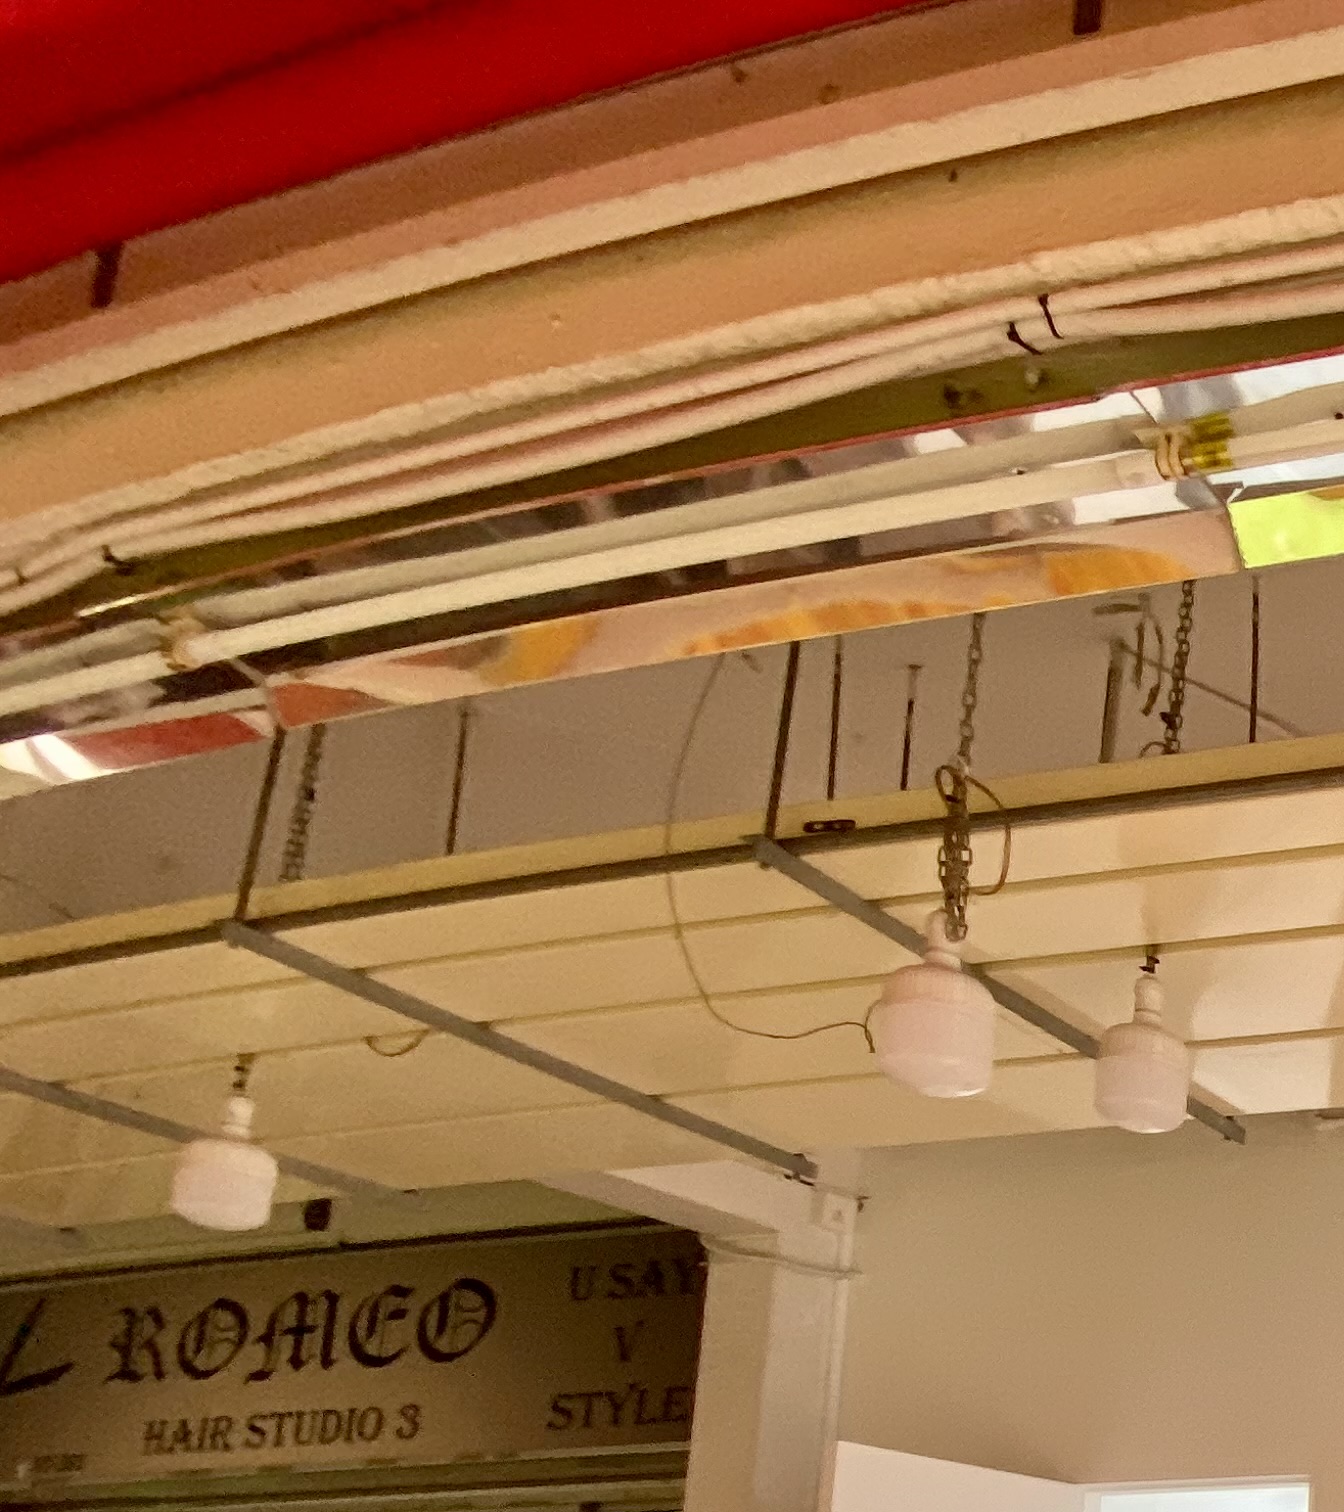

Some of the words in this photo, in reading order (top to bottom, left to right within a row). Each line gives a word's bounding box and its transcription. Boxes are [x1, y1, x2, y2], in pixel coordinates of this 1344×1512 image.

[103, 1277, 499, 1385] ROMEO
[142, 1416, 234, 1456] HAIR
[245, 1406, 384, 1448] STUDIO
[546, 1382, 691, 1430] STYLE
